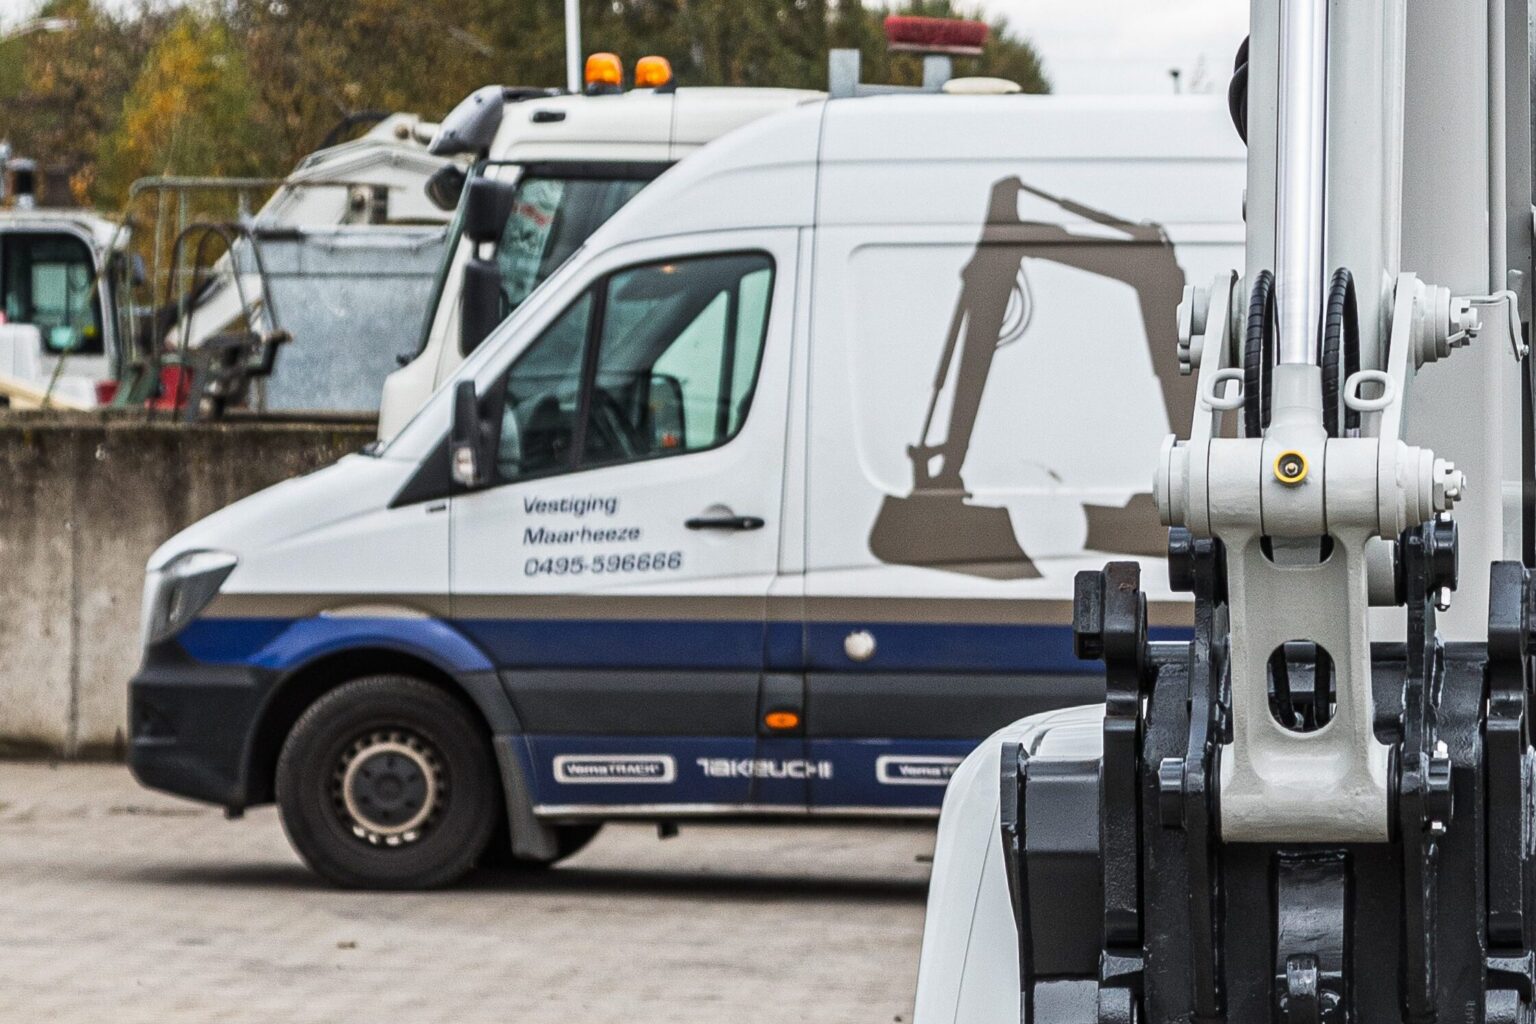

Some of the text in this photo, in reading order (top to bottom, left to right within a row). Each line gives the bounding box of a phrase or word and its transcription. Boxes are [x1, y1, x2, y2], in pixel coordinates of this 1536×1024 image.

[523, 495, 619, 517] Vestiging
[523, 526, 641, 545] Maarheeze
[524, 551, 683, 577] 0495-596666
[696, 757, 833, 779] TAKEUCHI
